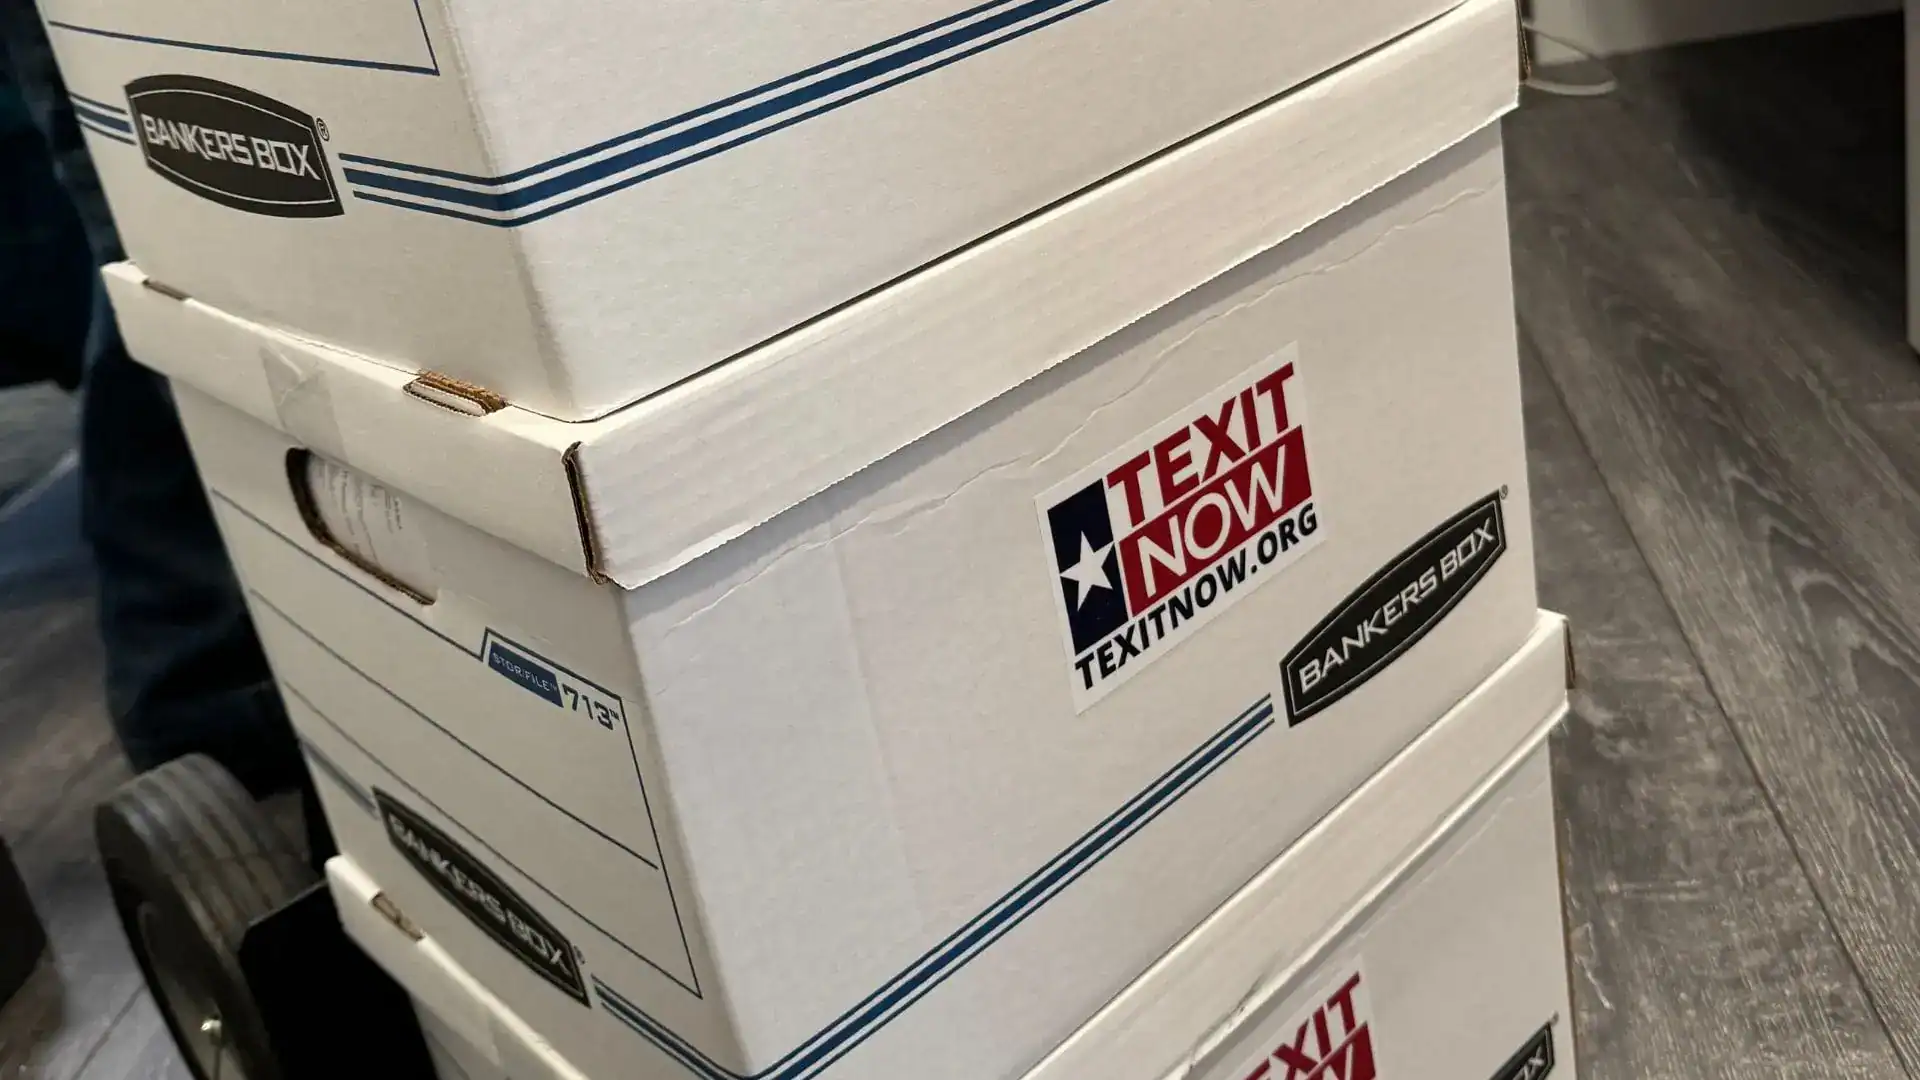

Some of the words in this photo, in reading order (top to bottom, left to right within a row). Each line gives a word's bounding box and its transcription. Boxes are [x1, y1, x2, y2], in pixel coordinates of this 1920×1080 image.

[140, 114, 254, 165] BANKERS
[250, 136, 321, 180] BOX
[1107, 361, 1294, 528] TEXIT
[1138, 444, 1290, 598] NOW
[1075, 503, 1318, 690] TEXITNOW.ORG
[1300, 575, 1438, 694] BANKERS
[1440, 517, 1496, 581] BOX
[387, 812, 507, 924] BANKERS
[506, 908, 574, 978] BOX
